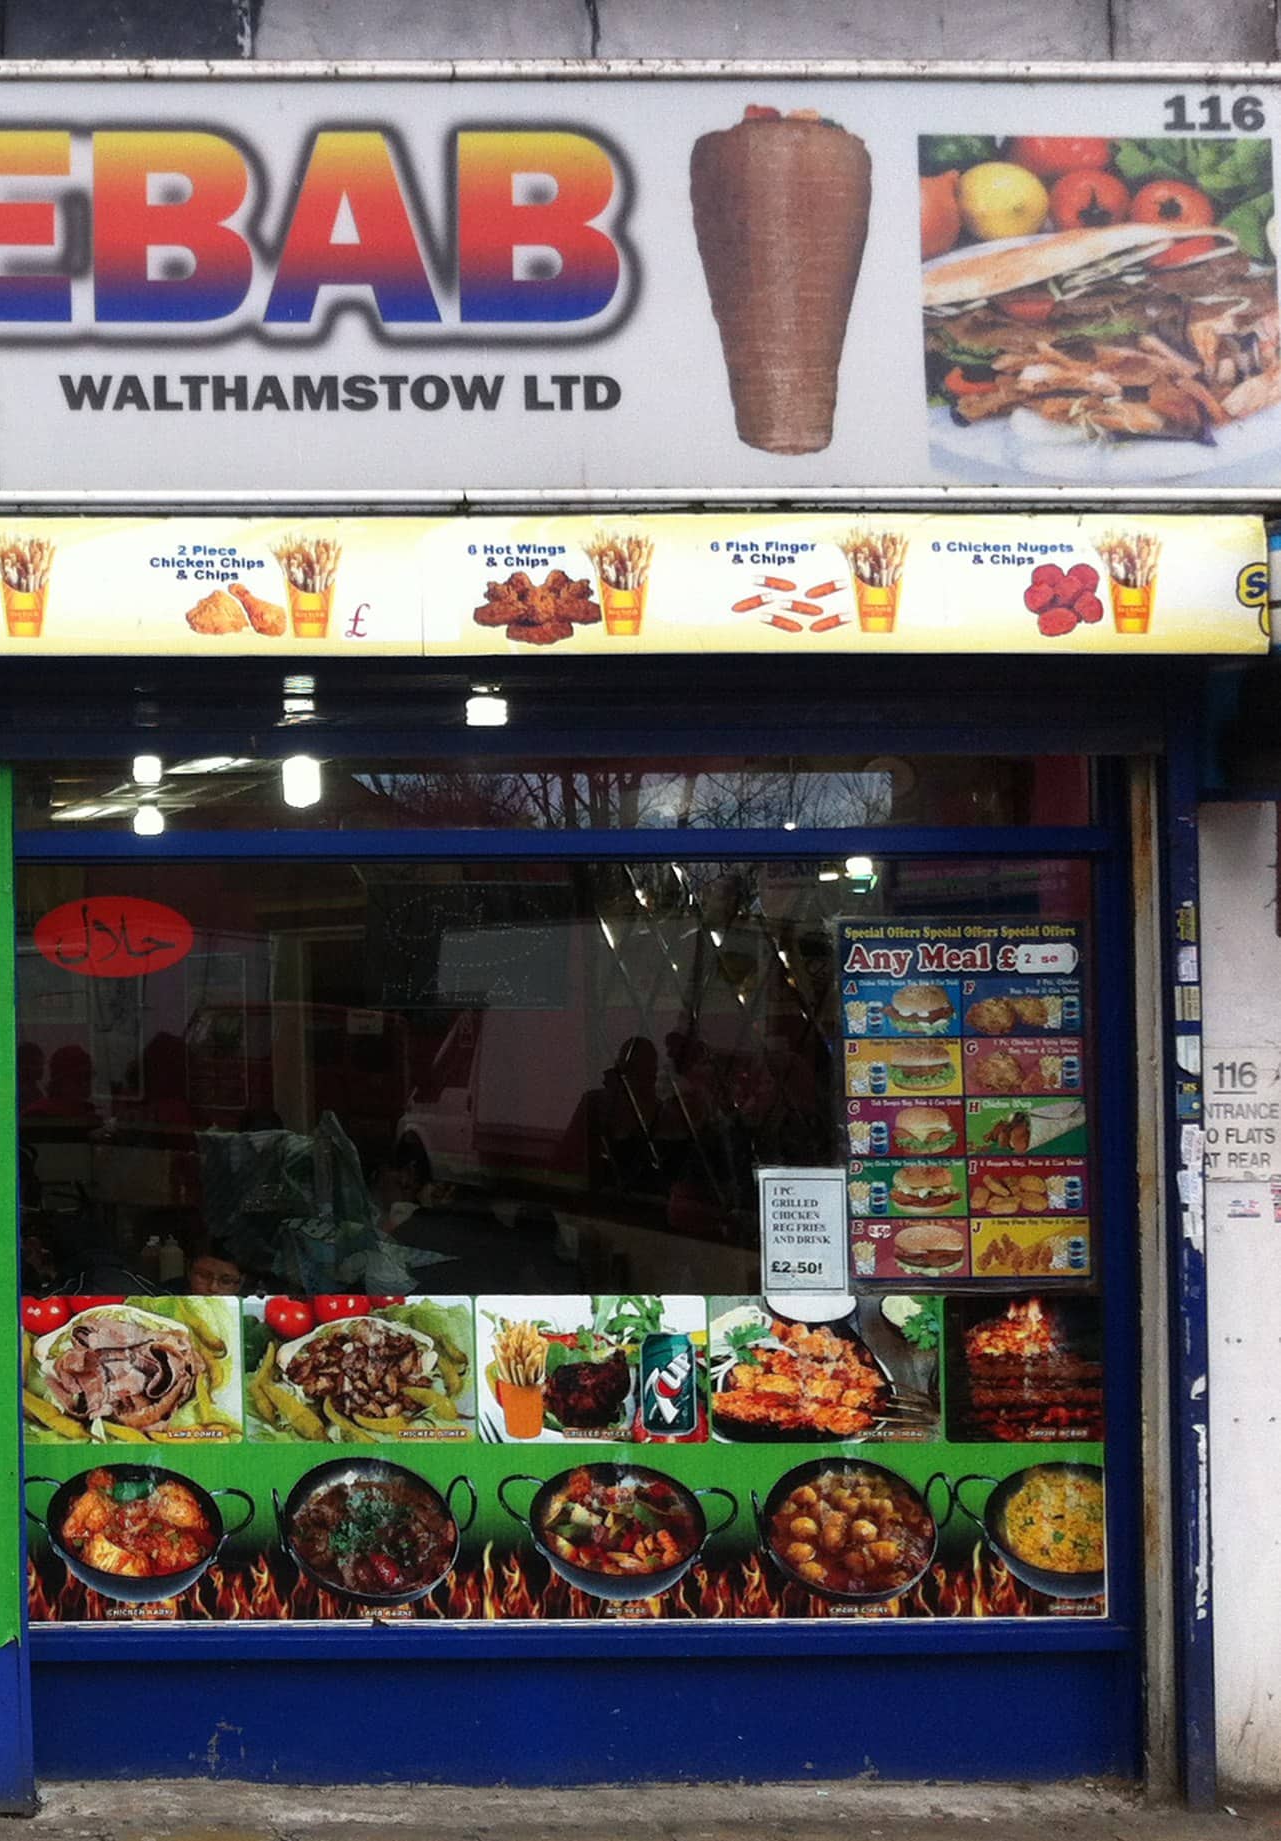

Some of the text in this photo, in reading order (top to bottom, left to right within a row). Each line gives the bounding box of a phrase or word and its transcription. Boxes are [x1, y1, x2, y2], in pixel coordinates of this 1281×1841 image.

[1163, 94, 1266, 131] 116
[59, 374, 622, 412] WALTHAMSTOW LTD
[177, 545, 237, 556] 2 Piece
[467, 544, 566, 557] 6 Hot Wings
[710, 541, 816, 554] 6 Fish Finger
[931, 541, 1074, 555] 6 Chicken Nugets
[149, 557, 265, 570] Chicken Chips
[486, 556, 549, 569] & Chips
[732, 554, 796, 566] & Chips
[972, 554, 1035, 566] & Chips
[176, 569, 239, 582] & Chips
[344, 603, 371, 638] £
[54, 904, 176, 965] حلال
[845, 925, 1076, 939] Special Offers Special Offers Special Offers
[845, 944, 913, 978] Any
[918, 943, 992, 971] Meal
[965, 1041, 978, 1055] G
[1212, 1061, 1258, 1089] 116
[968, 1100, 981, 1114] H
[1225, 1127, 1277, 1145] FLATS
[1227, 1151, 1272, 1169] REAR
[771, 1199, 819, 1208] GRILLED
[771, 1210, 820, 1220] CHICKEN
[772, 1223, 827, 1232] REG FRIES
[971, 1220, 983, 1235] J
[772, 1235, 831, 1245] AND DRINK
[771, 1261, 823, 1275] £2.50!
